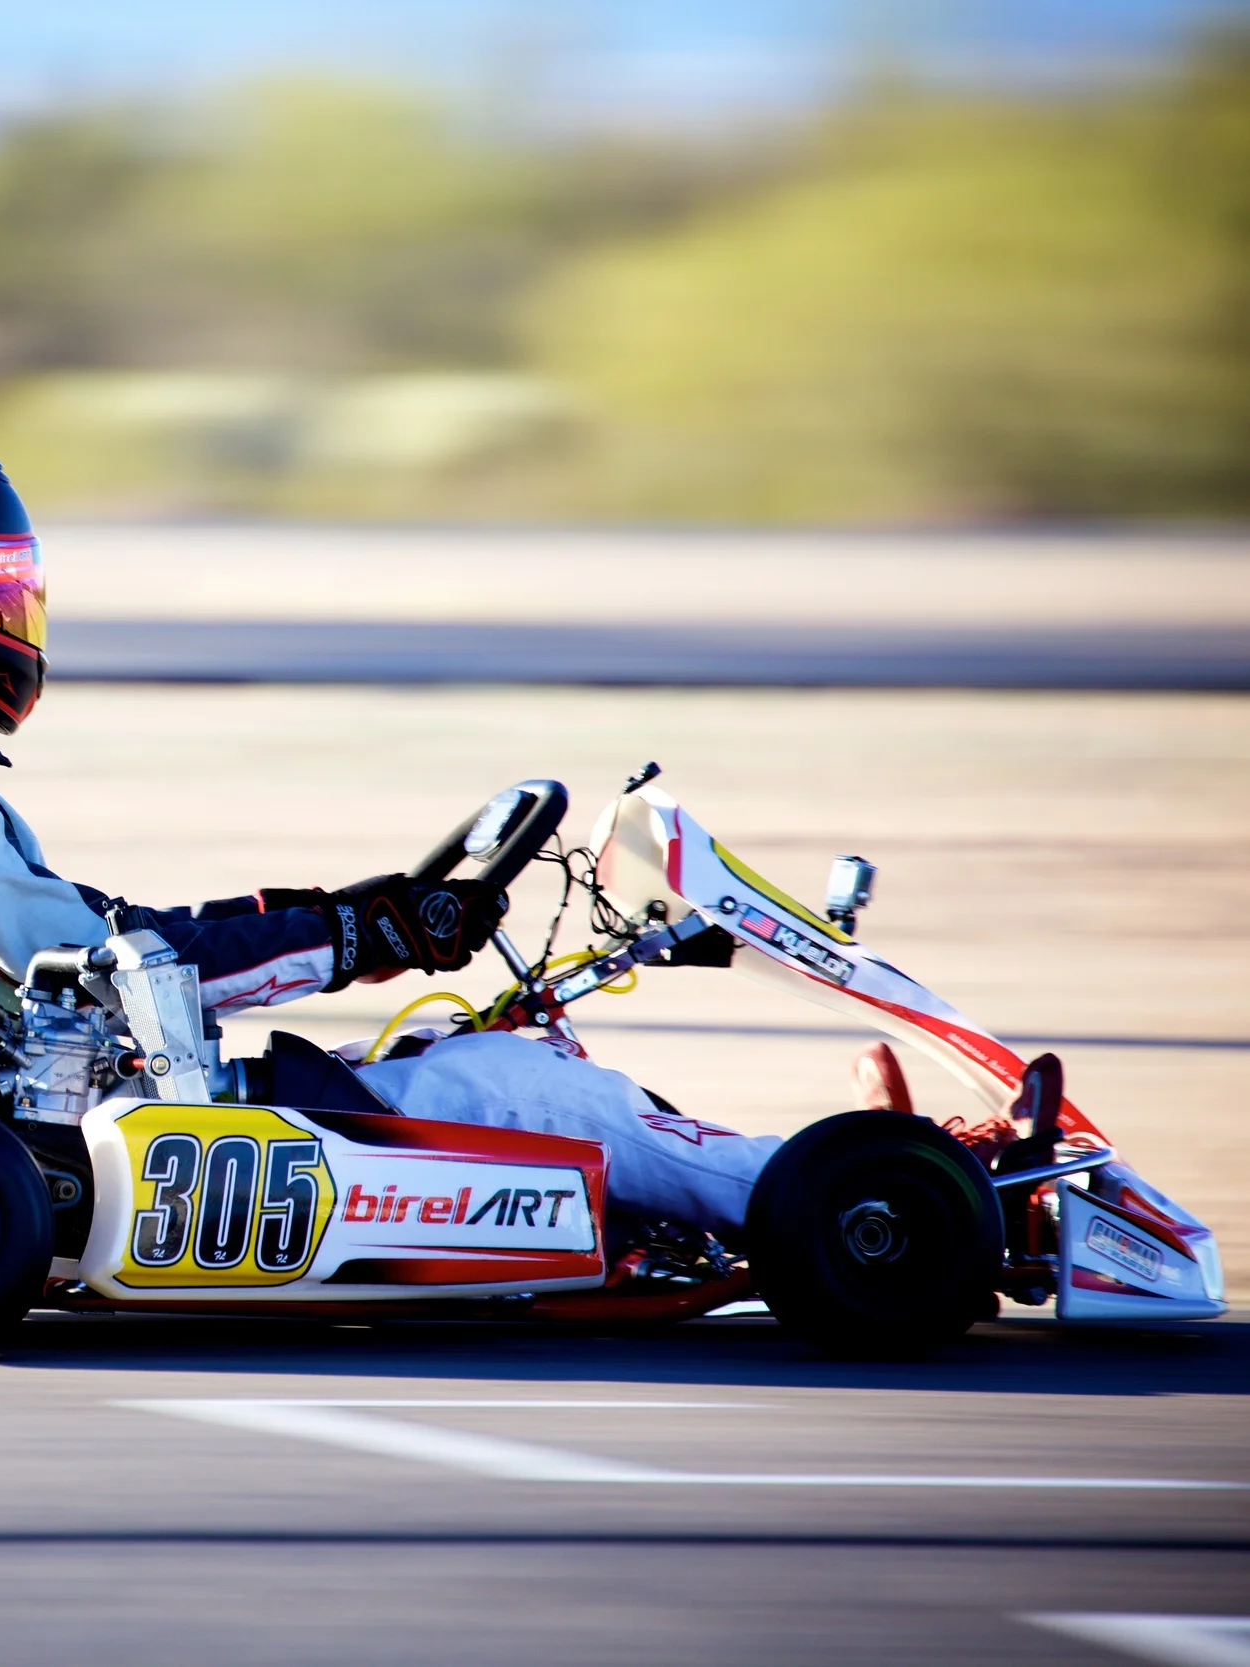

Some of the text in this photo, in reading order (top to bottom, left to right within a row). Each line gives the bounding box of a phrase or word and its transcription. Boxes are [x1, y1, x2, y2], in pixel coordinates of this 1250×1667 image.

[336, 904, 358, 971] sparco
[377, 917, 410, 959] sparco
[131, 1133, 323, 1273] 305
